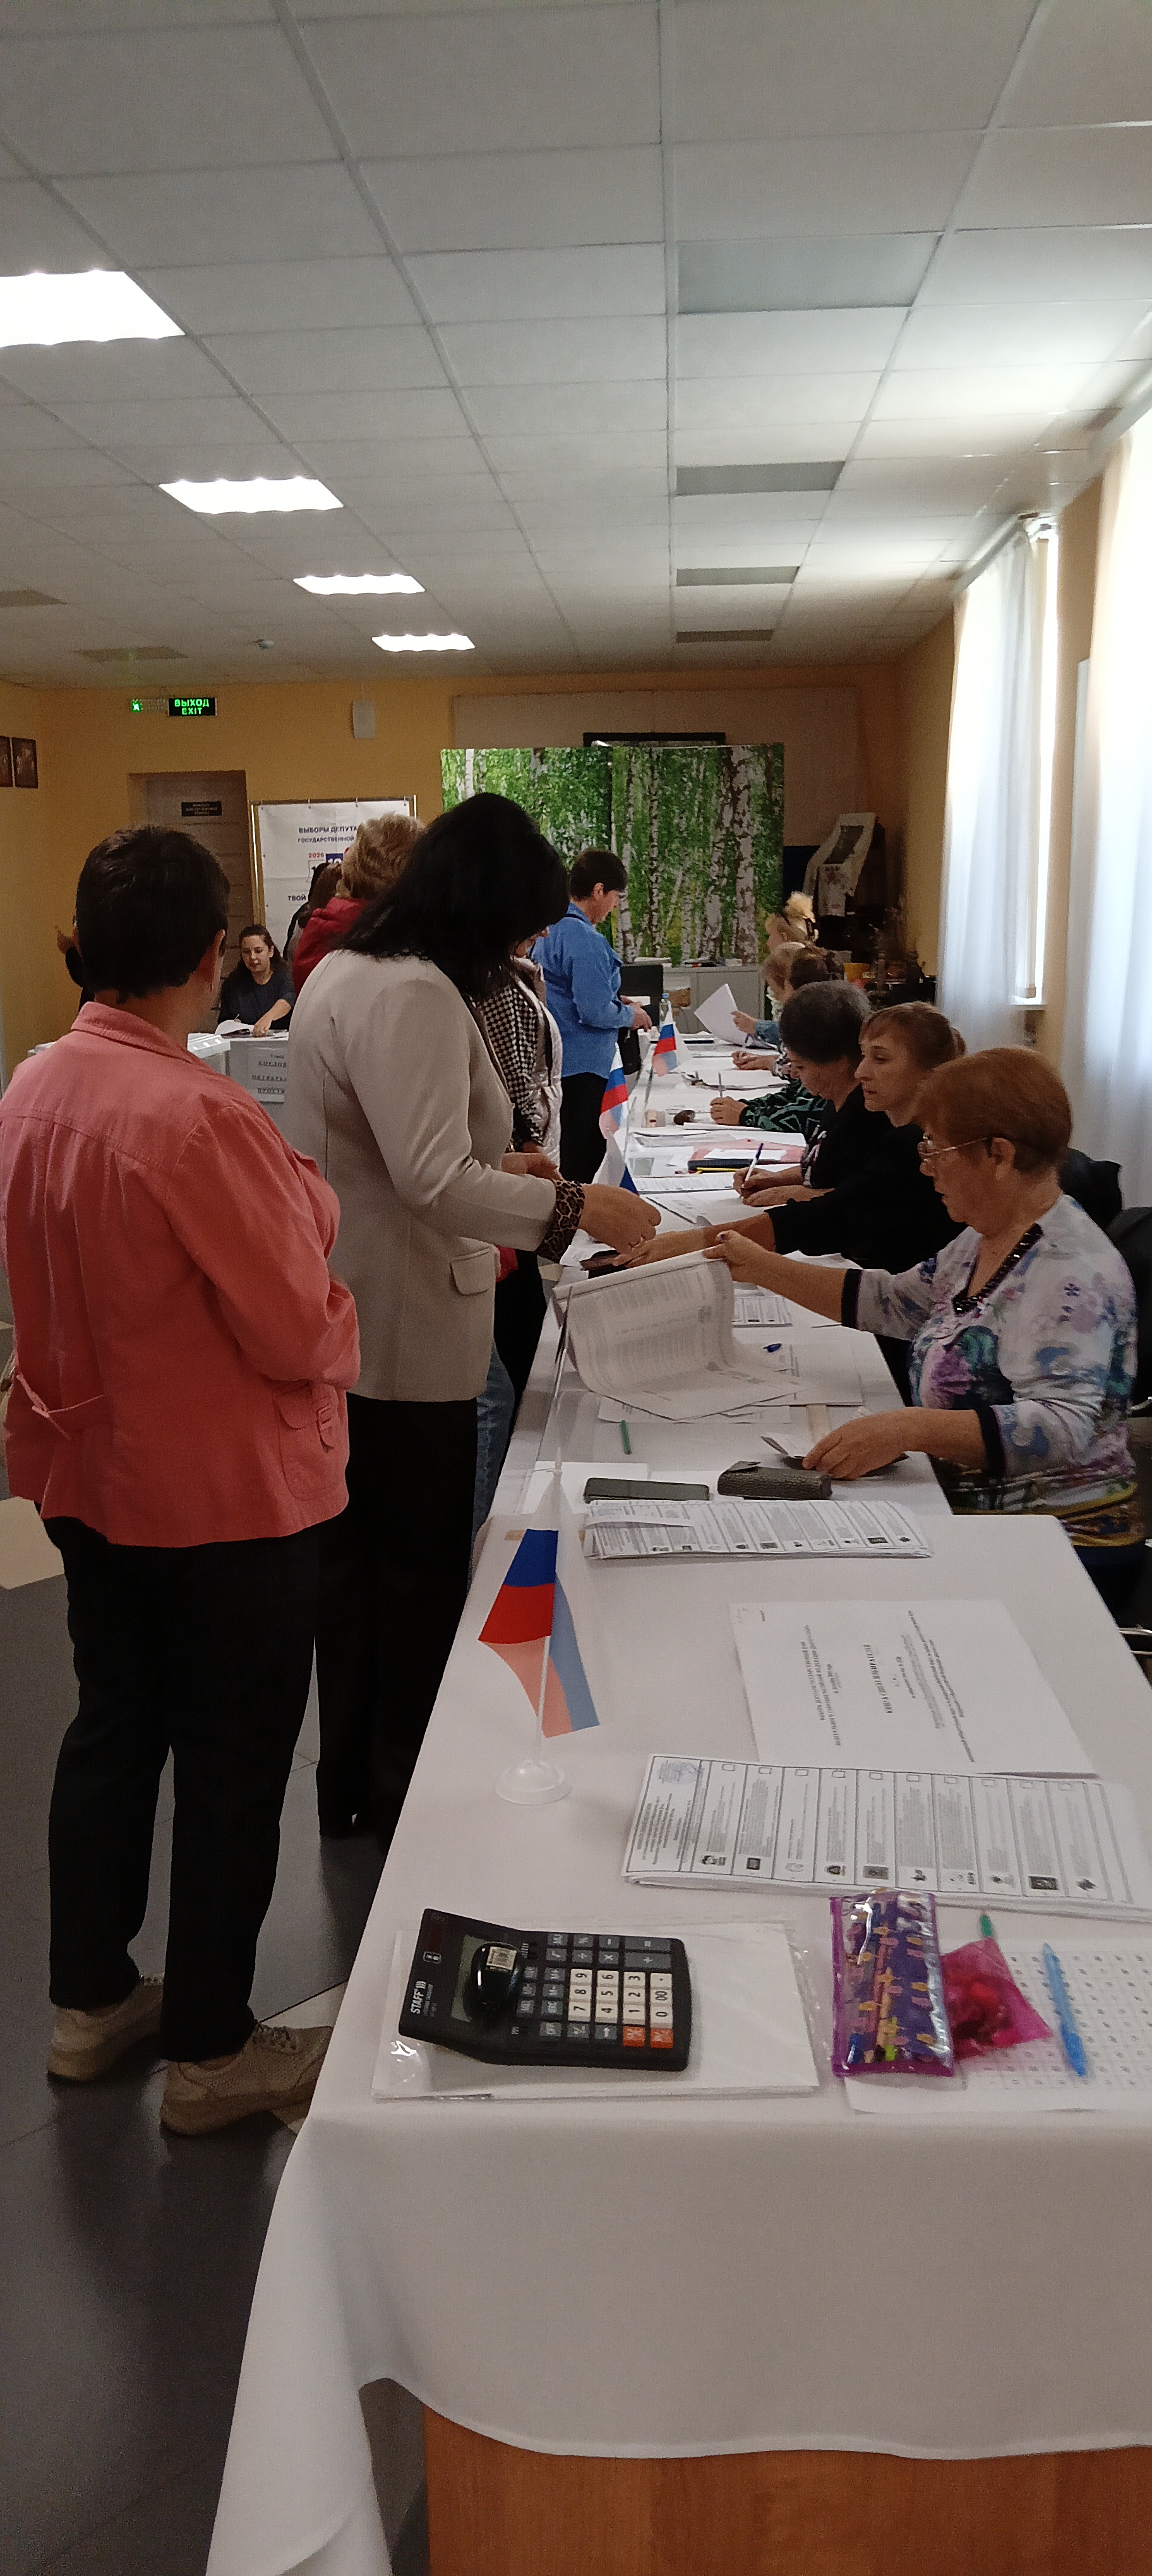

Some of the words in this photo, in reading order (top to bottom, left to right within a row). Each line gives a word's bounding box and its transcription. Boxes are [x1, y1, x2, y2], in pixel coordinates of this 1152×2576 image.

[174, 699, 209, 707] ВЫХОД
[655, 1991, 668, 2001] 00
[573, 2003, 586, 2011] 7
